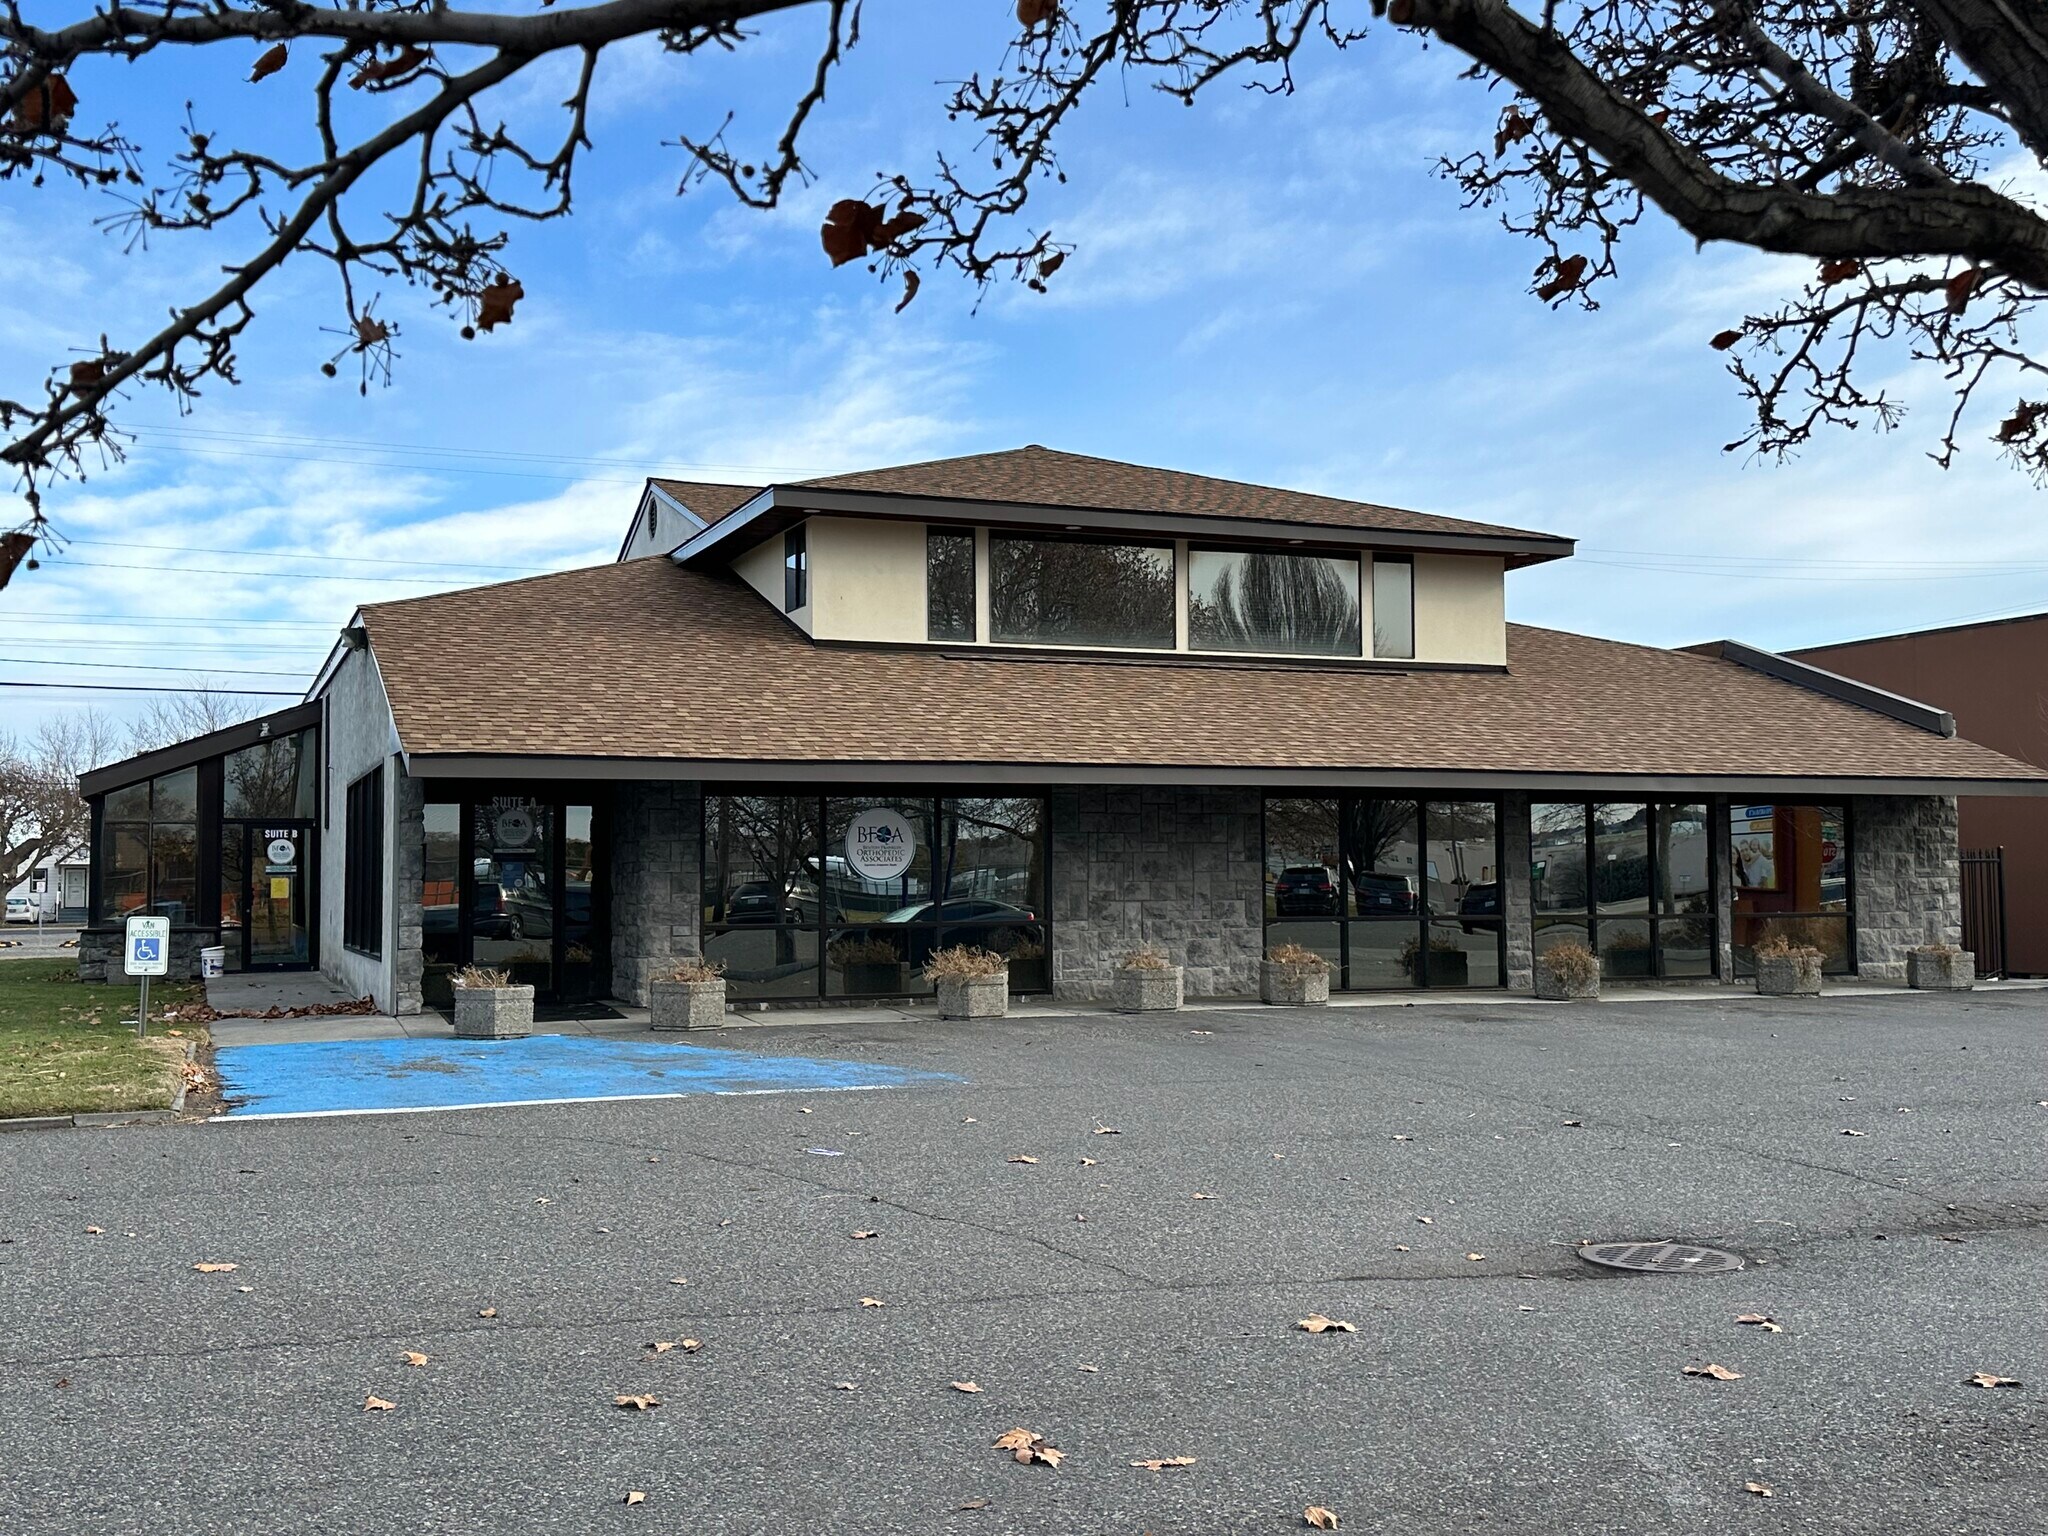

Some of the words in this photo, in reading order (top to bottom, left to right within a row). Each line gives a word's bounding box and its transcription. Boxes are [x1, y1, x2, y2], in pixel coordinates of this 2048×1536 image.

[492, 796, 524, 808] SUITE
[530, 797, 537, 808] A
[264, 829, 289, 838] SUITE
[292, 829, 298, 838] B
[857, 825, 904, 844] BFOA
[856, 848, 906, 857] ORTHOPEDIC
[860, 855, 903, 863] ASSOCIATES
[142, 921, 155, 929] VAN
[130, 929, 166, 938] ACCESSIBLE
